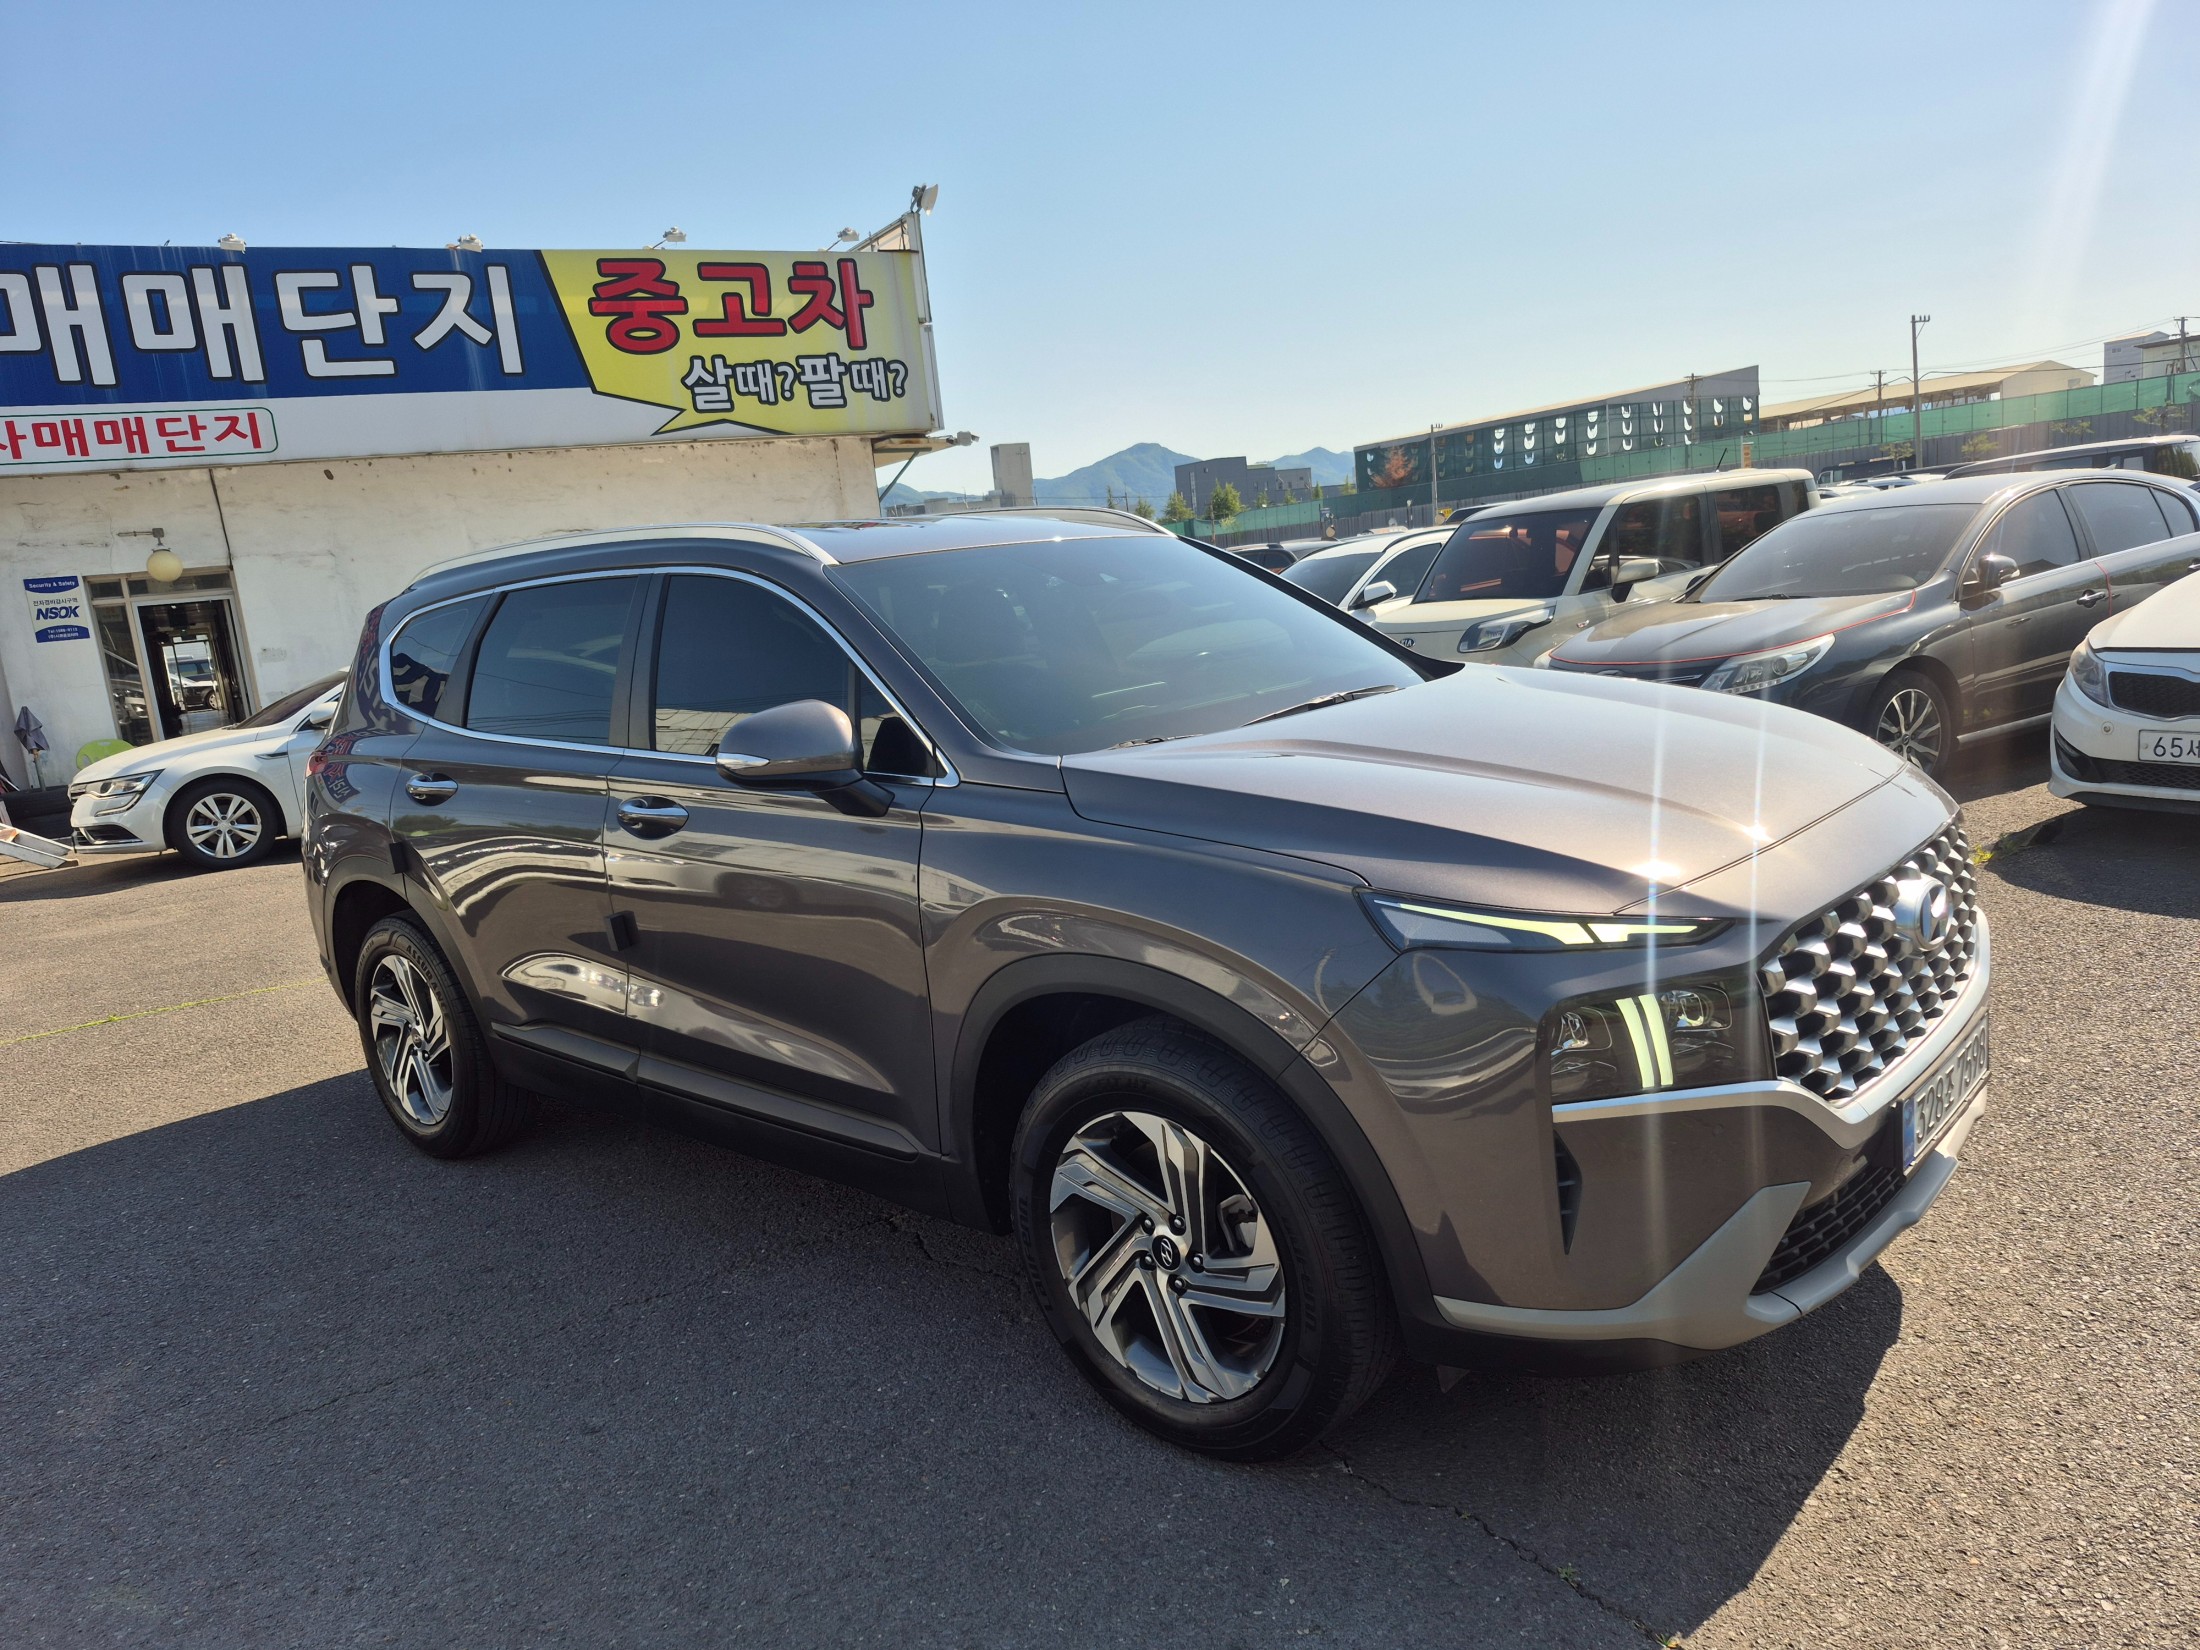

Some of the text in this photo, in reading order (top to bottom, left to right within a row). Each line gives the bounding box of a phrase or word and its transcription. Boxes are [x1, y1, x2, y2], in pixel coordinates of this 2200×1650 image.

[0, 263, 525, 386] 매매단지
[587, 257, 874, 355] 중고차
[36, 605, 80, 621] NSOK
